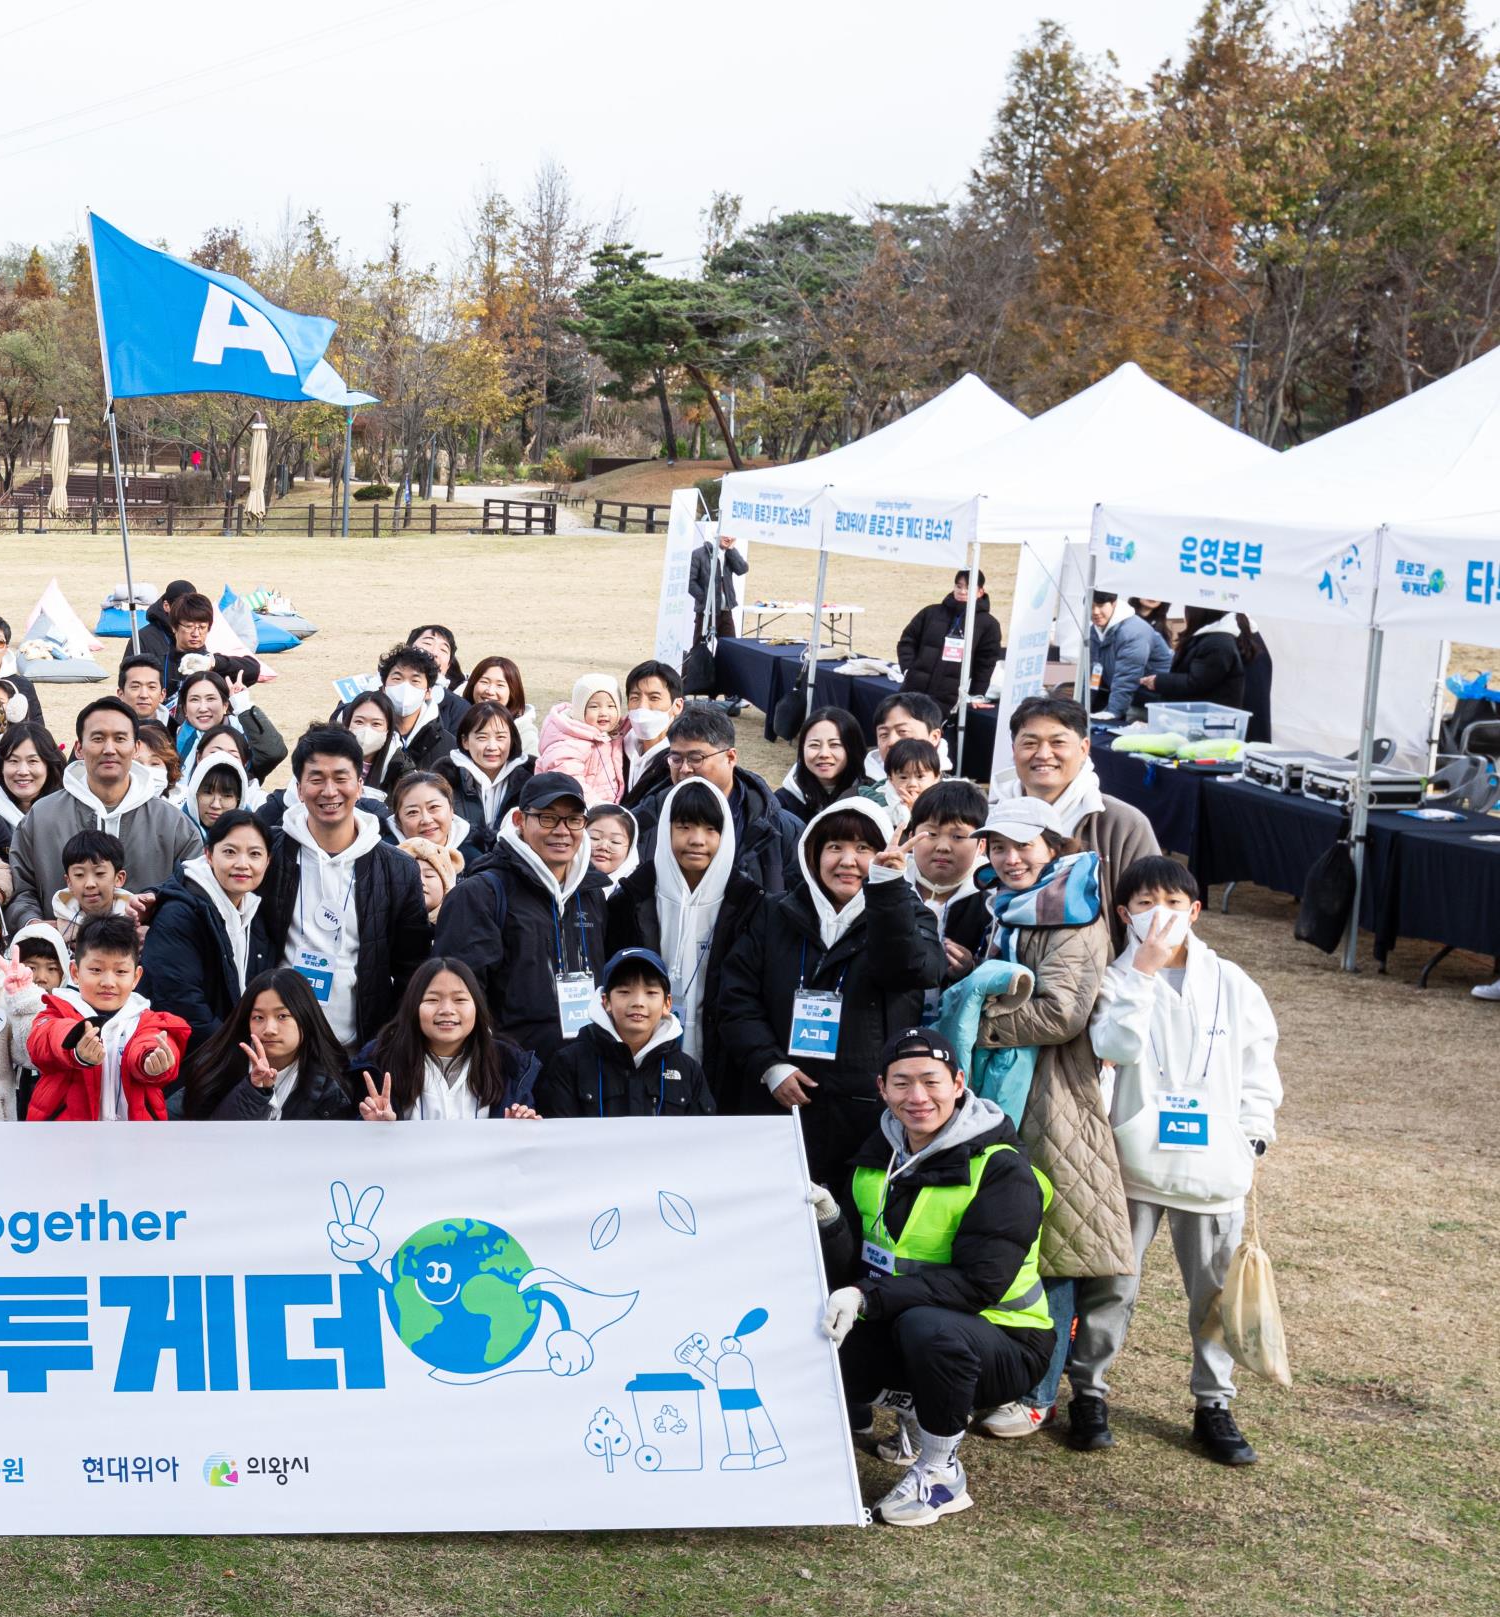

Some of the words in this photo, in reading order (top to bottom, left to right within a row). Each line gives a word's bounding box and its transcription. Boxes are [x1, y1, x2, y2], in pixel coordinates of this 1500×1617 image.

[193, 283, 296, 375] A
[836, 511, 867, 533] 현대위아
[869, 514, 895, 537] 플로깅
[895, 516, 923, 539] 투게더
[924, 518, 953, 542] 접수처
[1179, 535, 1263, 581] 운영본부
[1395, 559, 1425, 577] 플로깅
[1401, 580, 1431, 597] 투게더
[1466, 560, 1500, 605] 타
[323, 911, 339, 925] WIA
[800, 1028, 830, 1041] A그룹
[1166, 1120, 1201, 1134] A그룹
[82, 1456, 180, 1484] 현대위아
[246, 1456, 310, 1486] 의왕시
